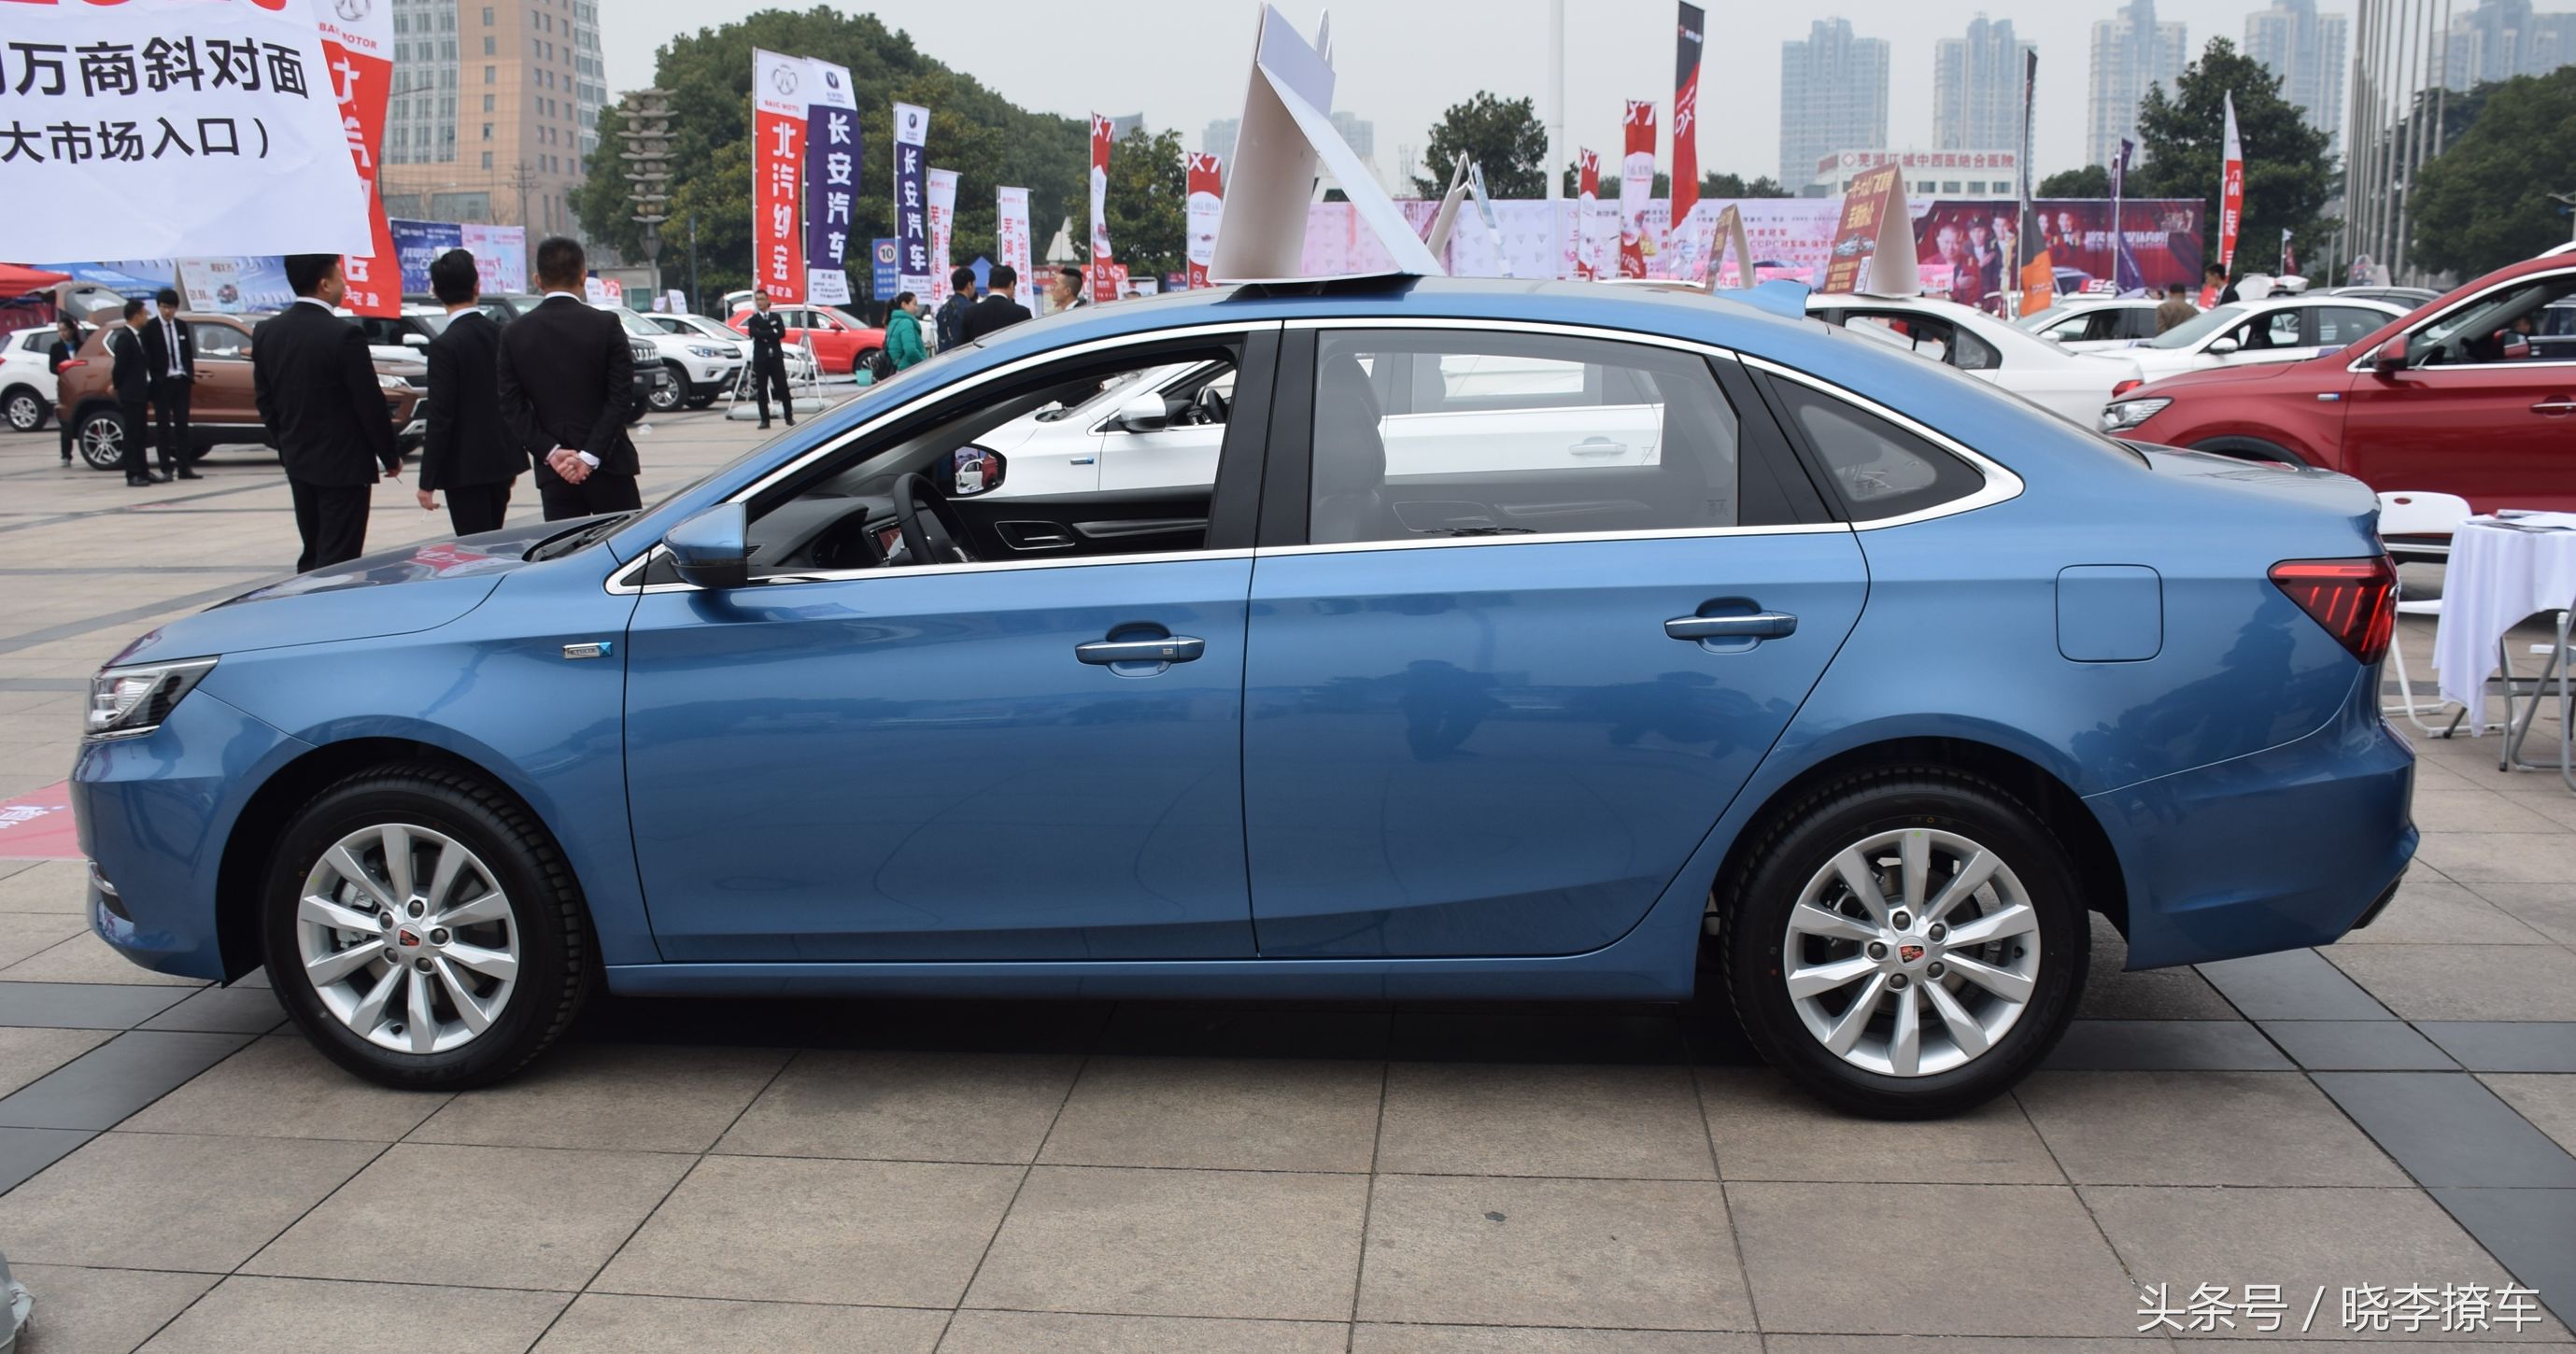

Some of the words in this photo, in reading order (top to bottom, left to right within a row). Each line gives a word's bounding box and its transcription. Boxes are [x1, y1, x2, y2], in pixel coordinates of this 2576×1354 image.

[0, 35, 309, 100] 万商斜对面
[771, 120, 797, 281] 北汽绅宝
[827, 111, 853, 265] 长安汽车
[903, 148, 927, 272] 长安汽车
[880, 247, 895, 261] 10
